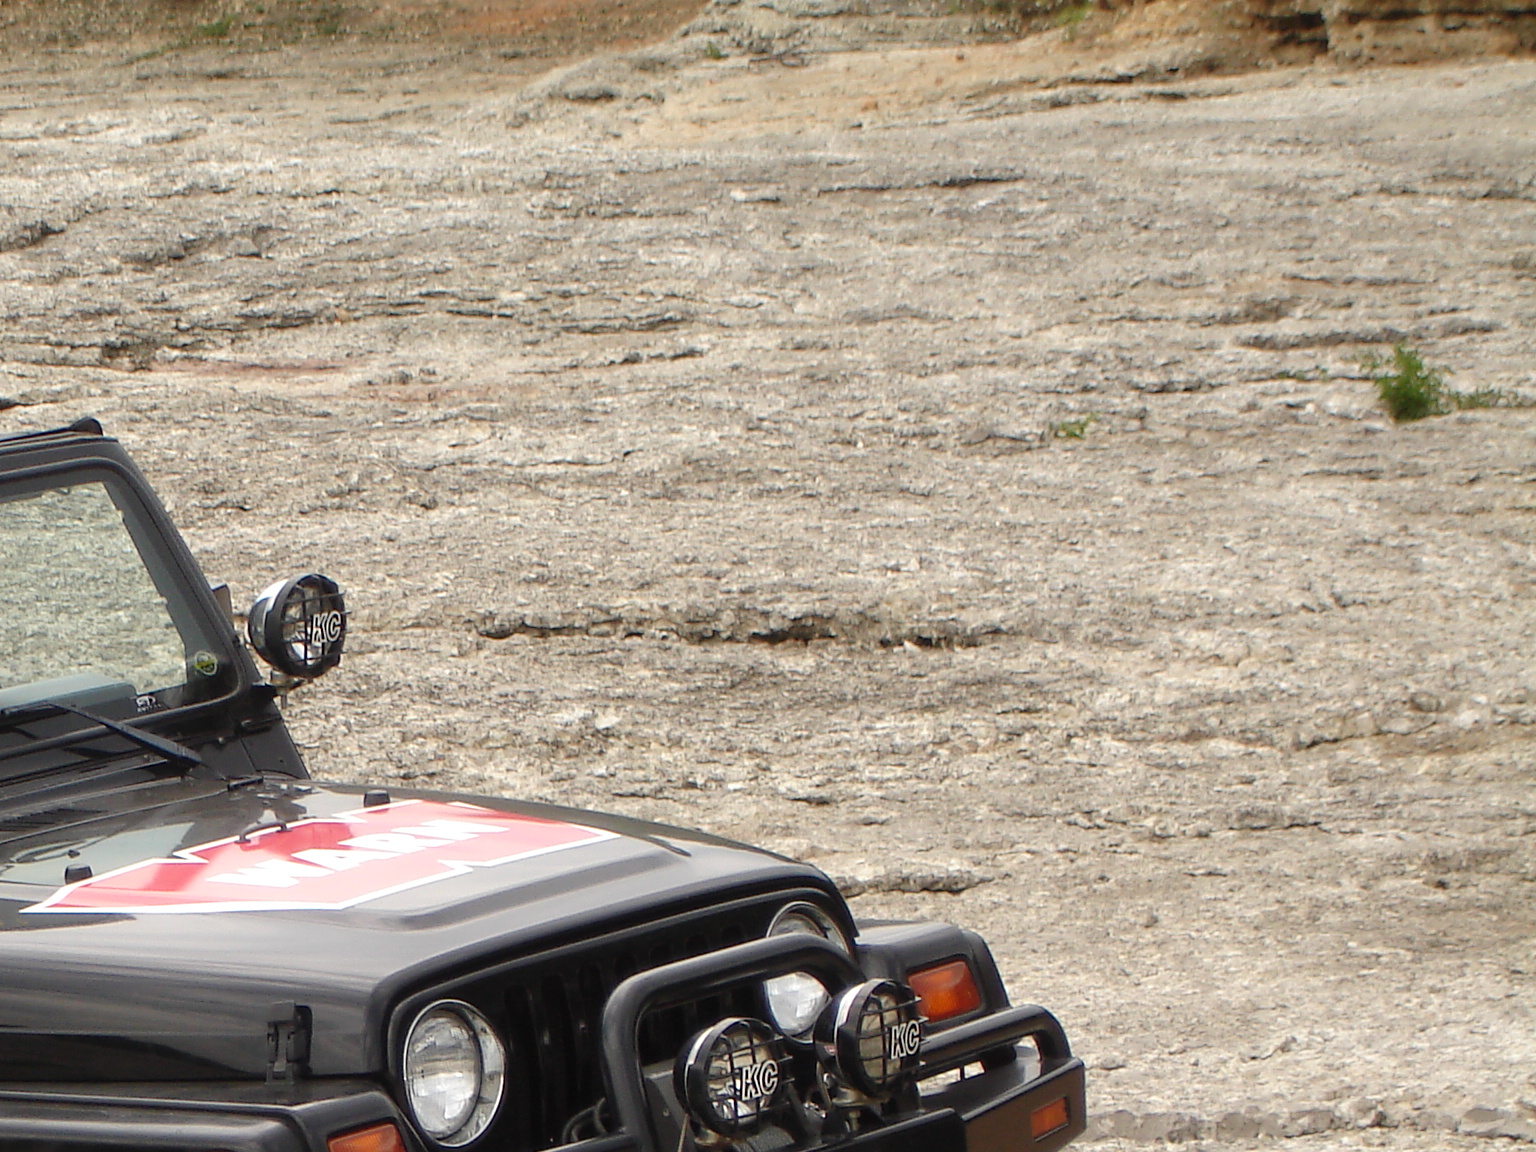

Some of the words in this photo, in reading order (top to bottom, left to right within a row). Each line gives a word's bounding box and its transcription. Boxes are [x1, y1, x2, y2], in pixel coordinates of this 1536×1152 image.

[311, 610, 343, 645] KC
[206, 818, 510, 888] WARN
[890, 1019, 921, 1060] KC
[741, 1059, 780, 1102] KC
